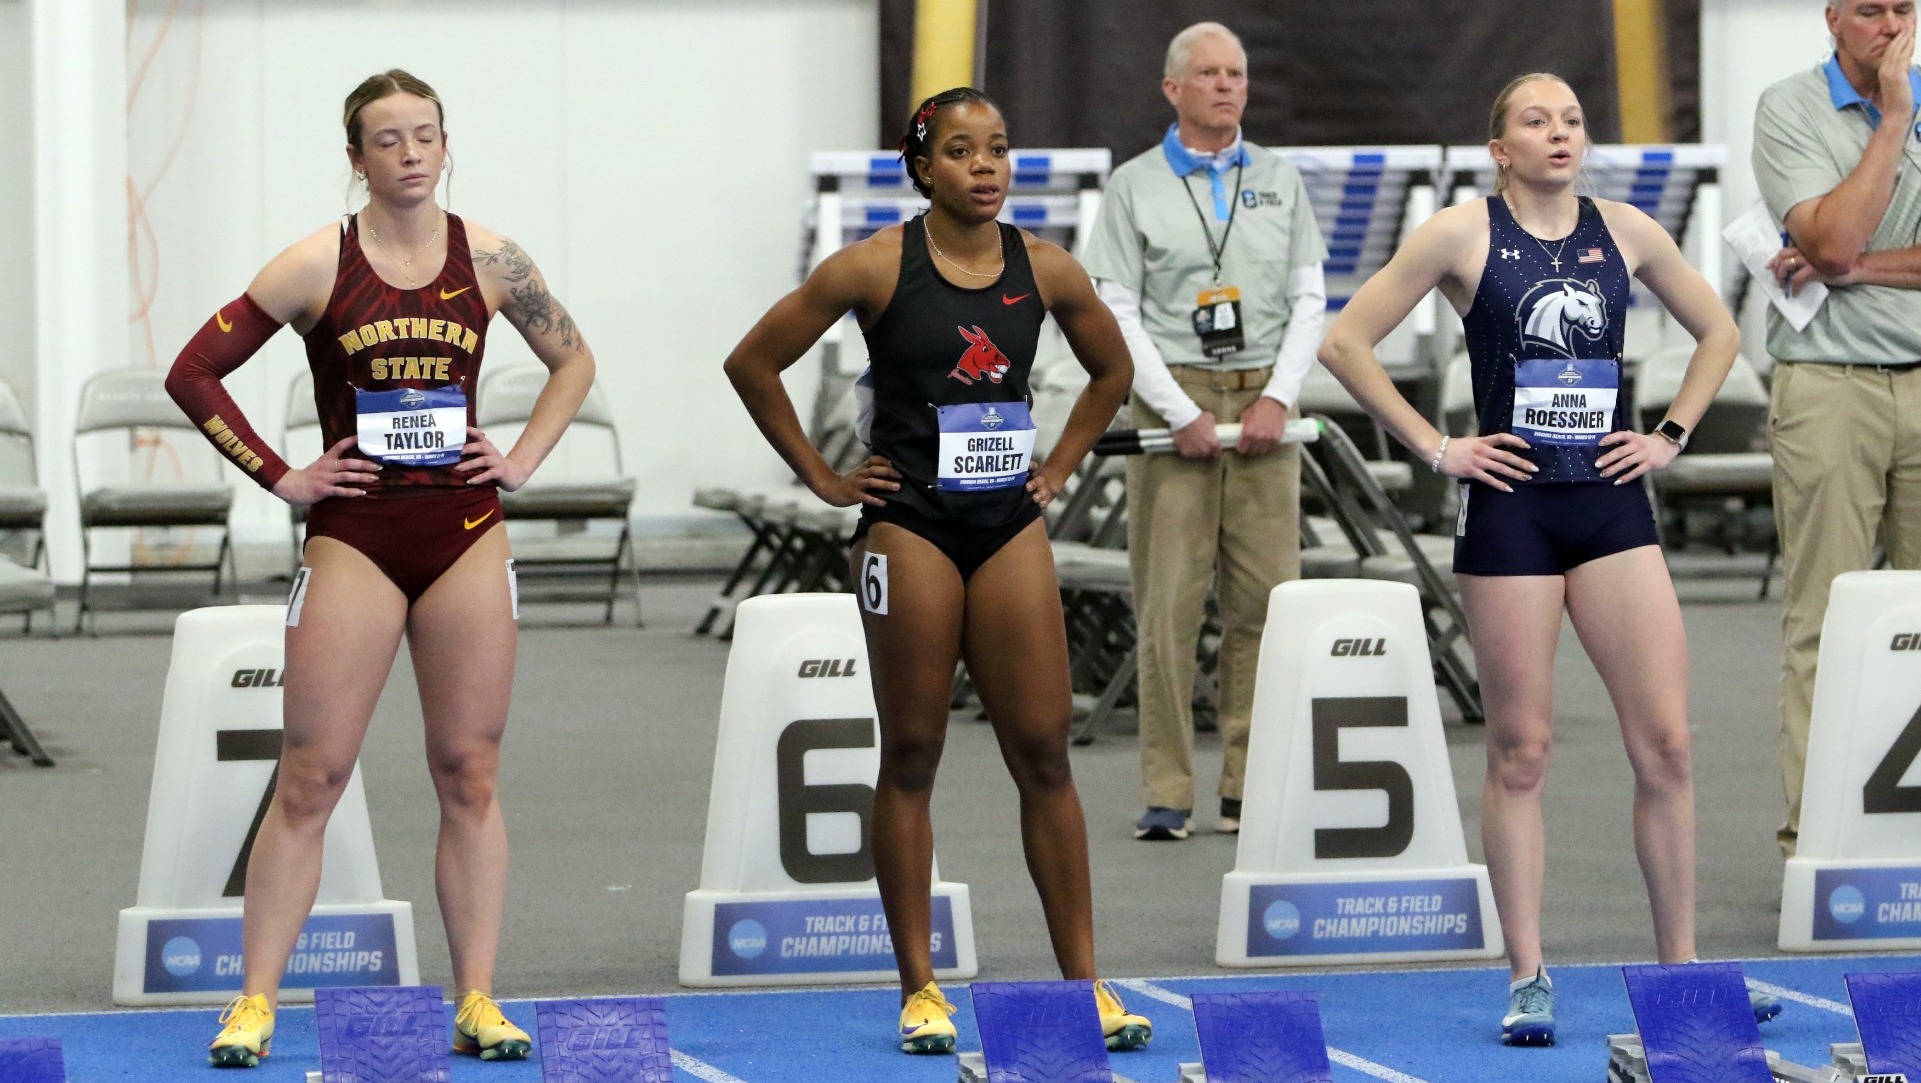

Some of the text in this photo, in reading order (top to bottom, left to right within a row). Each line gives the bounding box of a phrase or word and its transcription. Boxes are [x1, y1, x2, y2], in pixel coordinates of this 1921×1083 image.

[337, 317, 479, 356] NORTHERN
[371, 357, 452, 380] STATE
[1551, 393, 1587, 408] ANNA
[392, 414, 436, 430] RENEA
[1525, 408, 1604, 429] ROESSNER
[203, 414, 264, 473] WOLVES
[384, 430, 445, 450] TAYLOR
[967, 437, 1014, 452] GRIZELL
[954, 453, 1024, 474] SCARLETT
[866, 555, 882, 610] 6
[1330, 638, 1387, 657] GILL
[797, 658, 858, 679] GILL
[1311, 696, 1415, 859] 5
[776, 717, 876, 884] 6
[216, 729, 285, 897] 7
[1337, 895, 1442, 914] TRACK & FIELD
[805, 914, 855, 934] TRACK
[858, 914, 871, 931] &
[1267, 919, 1299, 930] NCAA
[1313, 913, 1468, 939] CHAMPIONSHIPS
[311, 931, 355, 949] FIELD
[733, 937, 765, 949] NCAA
[781, 932, 942, 958] CHAMPIONSS
[166, 955, 201, 967] NCAA
[215, 951, 382, 976] CHIONSHIPS
[345, 1014, 418, 1037] GILL
[567, 1027, 641, 1050] GILL
